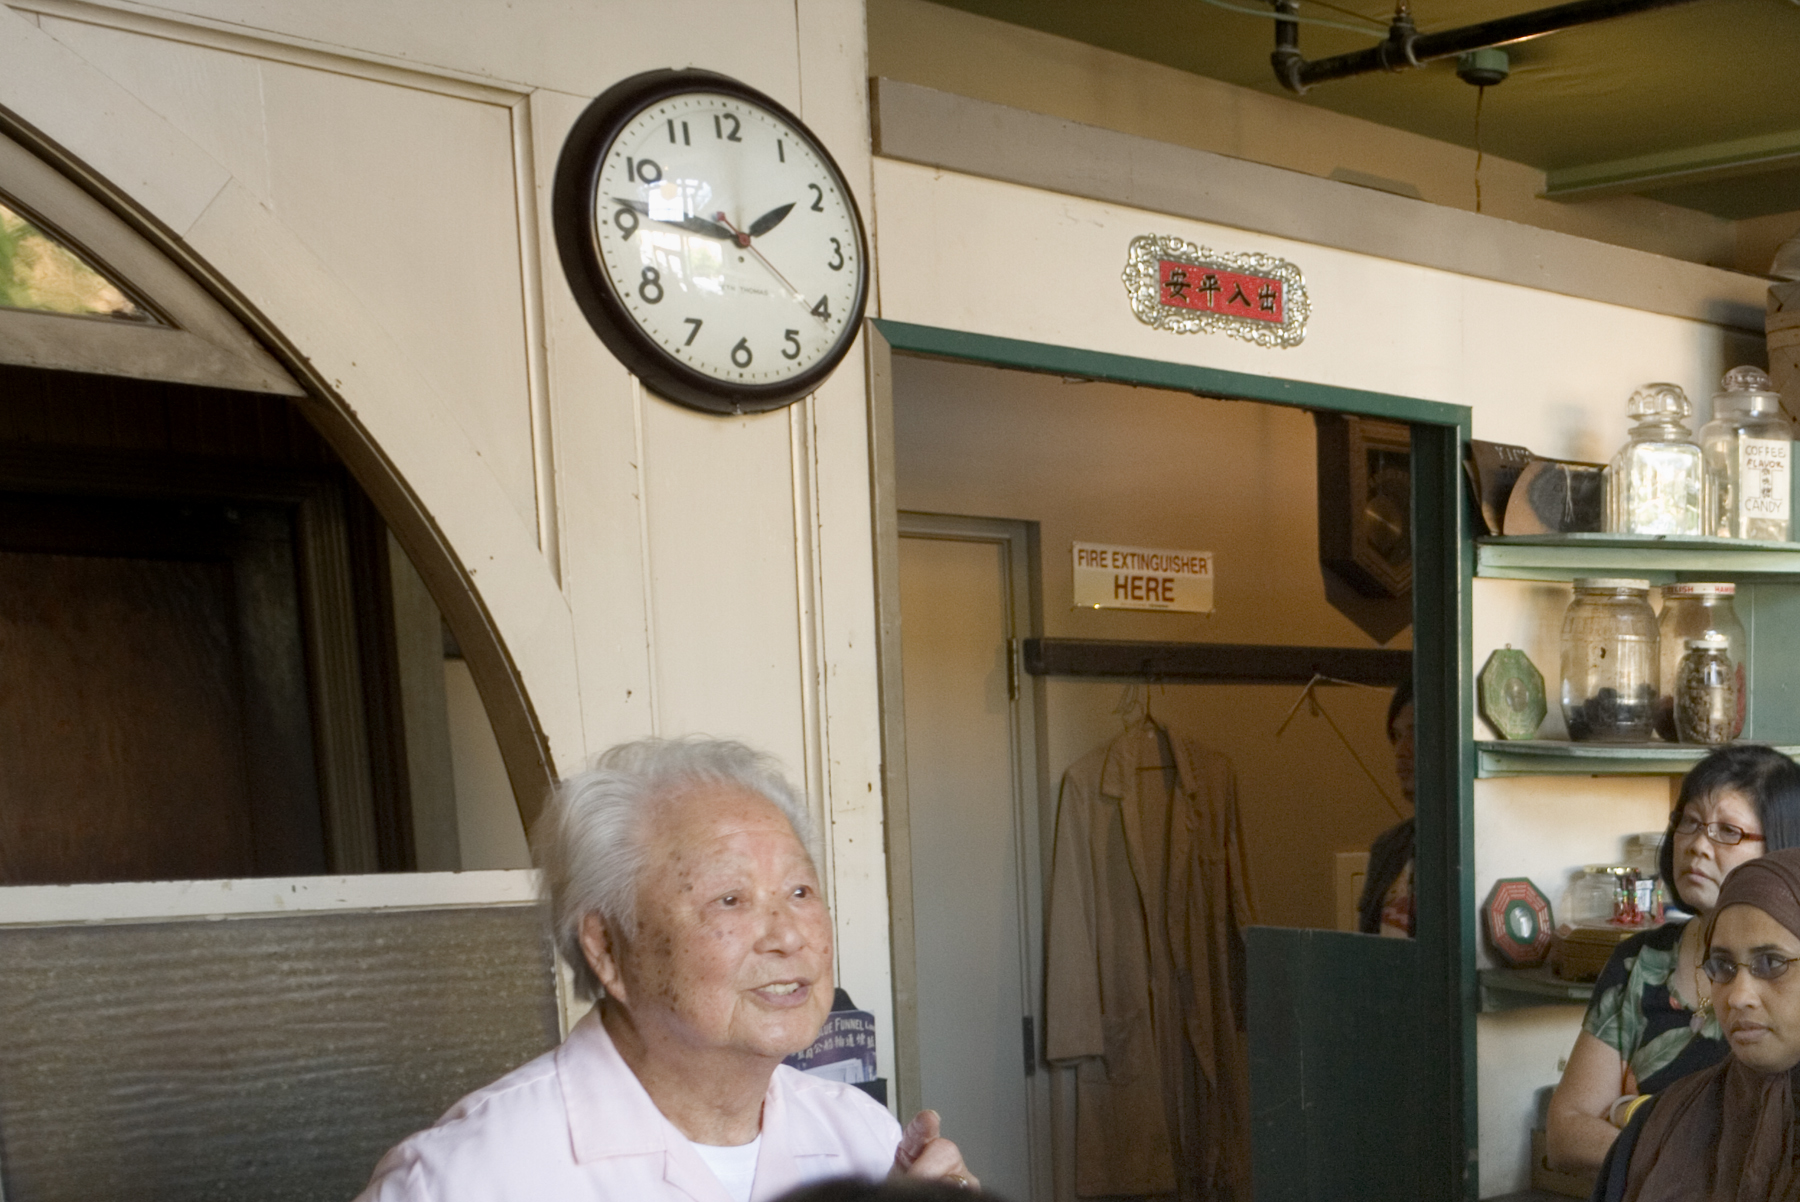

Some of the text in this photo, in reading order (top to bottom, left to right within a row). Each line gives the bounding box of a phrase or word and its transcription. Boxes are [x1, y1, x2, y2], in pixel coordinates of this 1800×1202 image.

[667, 118, 691, 146] 11
[714, 112, 742, 143] 12
[777, 138, 785, 163] 1
[626, 156, 662, 184] 10
[808, 183, 824, 213] 2
[614, 206, 639, 242] 9
[828, 237, 845, 272] 3
[638, 266, 664, 305] 8
[810, 295, 832, 323] 4
[684, 317, 704, 347] 7
[781, 329, 801, 360] 5
[730, 336, 753, 369] 6
[1744, 445, 1786, 459] COFFEE
[1746, 458, 1784, 469] FLAVOR
[1744, 498, 1782, 513] CANDY
[1078, 549, 1208, 574] FIRE EXTINGUISHER
[1114, 574, 1175, 602] HERE
